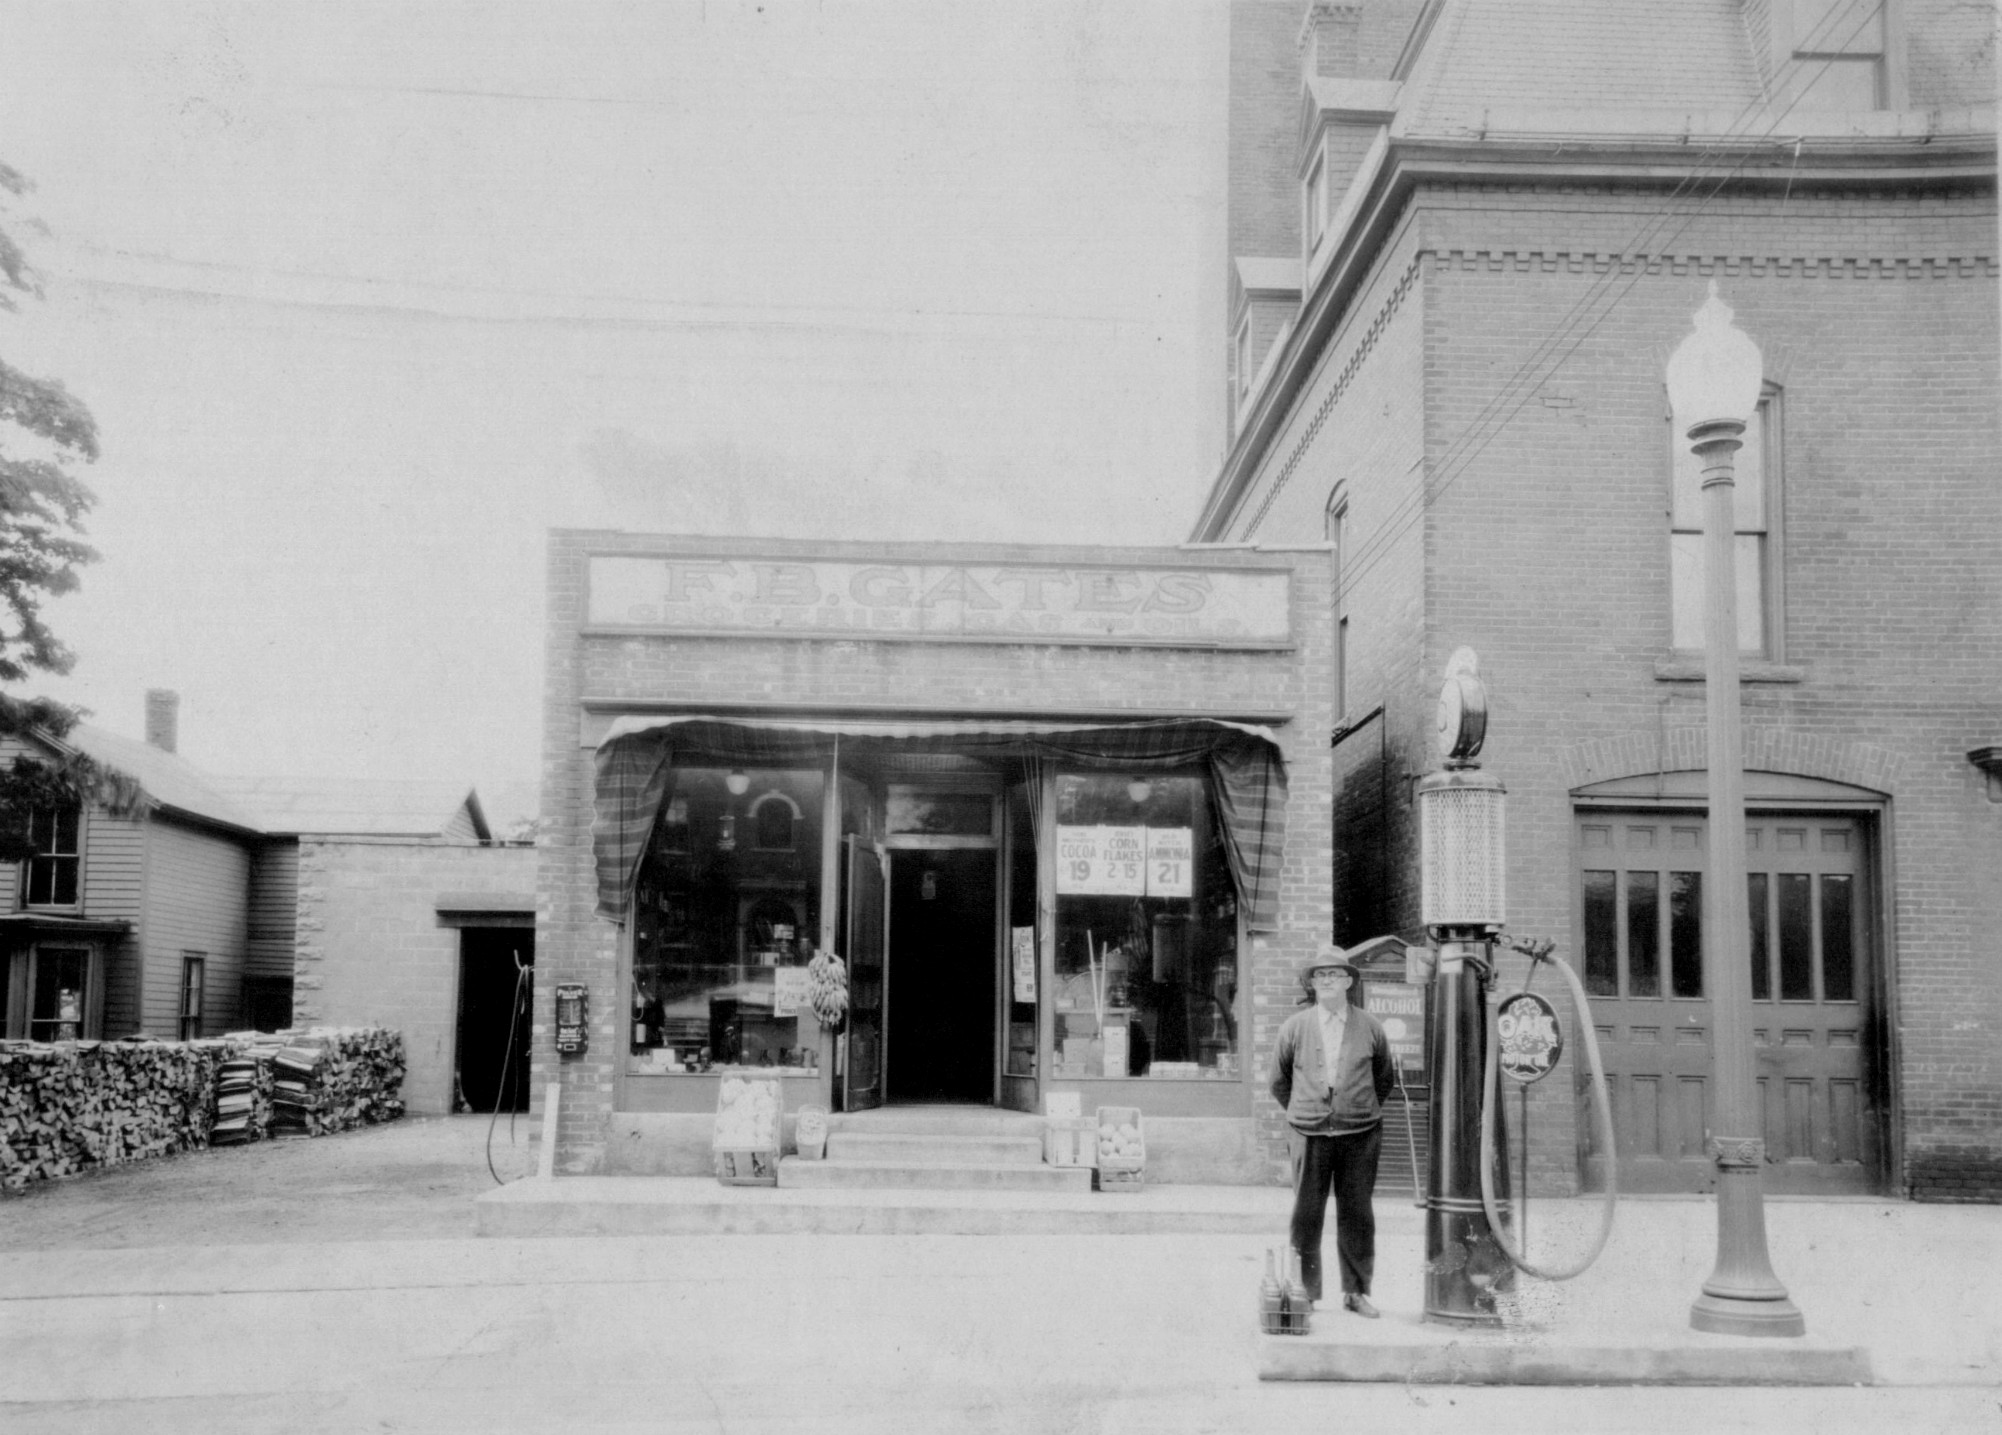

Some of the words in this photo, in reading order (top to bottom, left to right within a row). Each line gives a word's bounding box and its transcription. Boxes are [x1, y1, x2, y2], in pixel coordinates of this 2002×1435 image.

[1061, 844, 1096, 858] COCOA
[1109, 837, 1138, 849] CORN
[1104, 849, 1143, 861] FLAKES
[1070, 859, 1091, 881] 19
[1107, 862, 1116, 878] 2
[1123, 862, 1137, 880] 15
[1158, 861, 1180, 884] 21
[1367, 998, 1423, 1015] ALCOHOL
